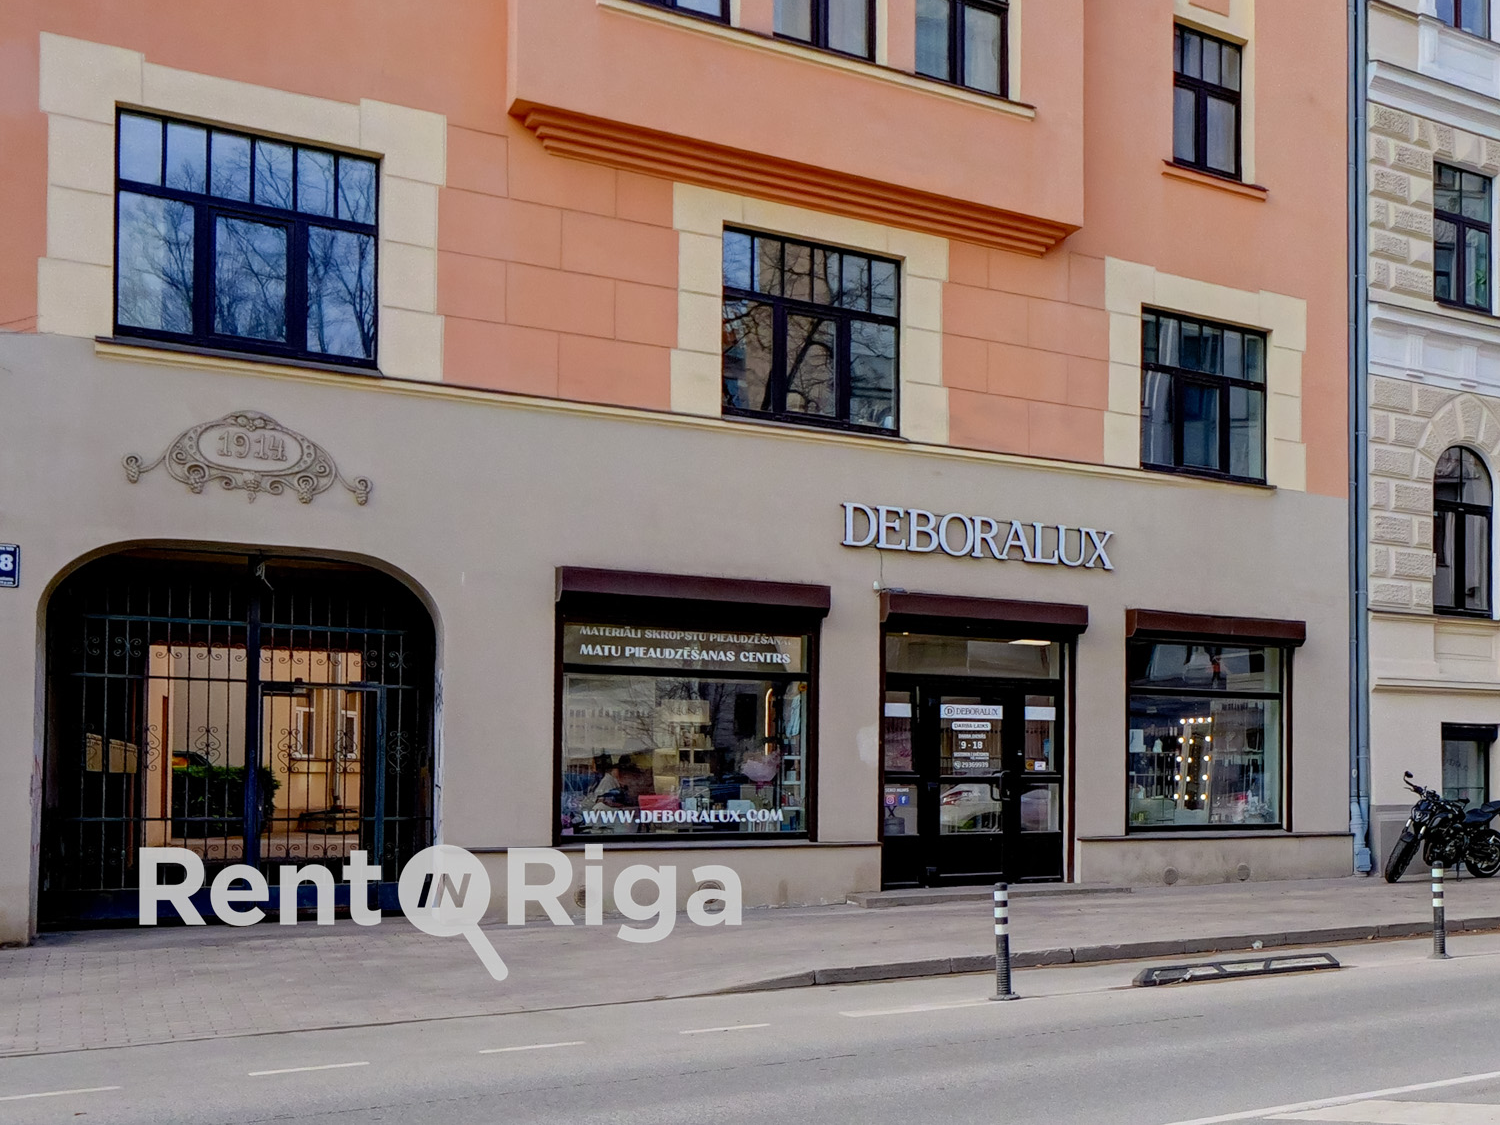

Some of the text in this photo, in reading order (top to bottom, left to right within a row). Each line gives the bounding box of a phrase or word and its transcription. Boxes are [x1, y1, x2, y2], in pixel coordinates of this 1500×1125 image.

[217, 431, 288, 462] 1914
[840, 502, 1115, 570] DEBORALUX
[579, 626, 642, 638] MATERIĀLI
[579, 644, 791, 664] MATU PIEAUDZĒŠANAS CENTRS
[956, 707, 998, 716] DEBORALUX
[960, 741, 967, 749] 9
[972, 741, 983, 749] 18
[583, 809, 784, 824] WWW.DEBORALUX.COM
